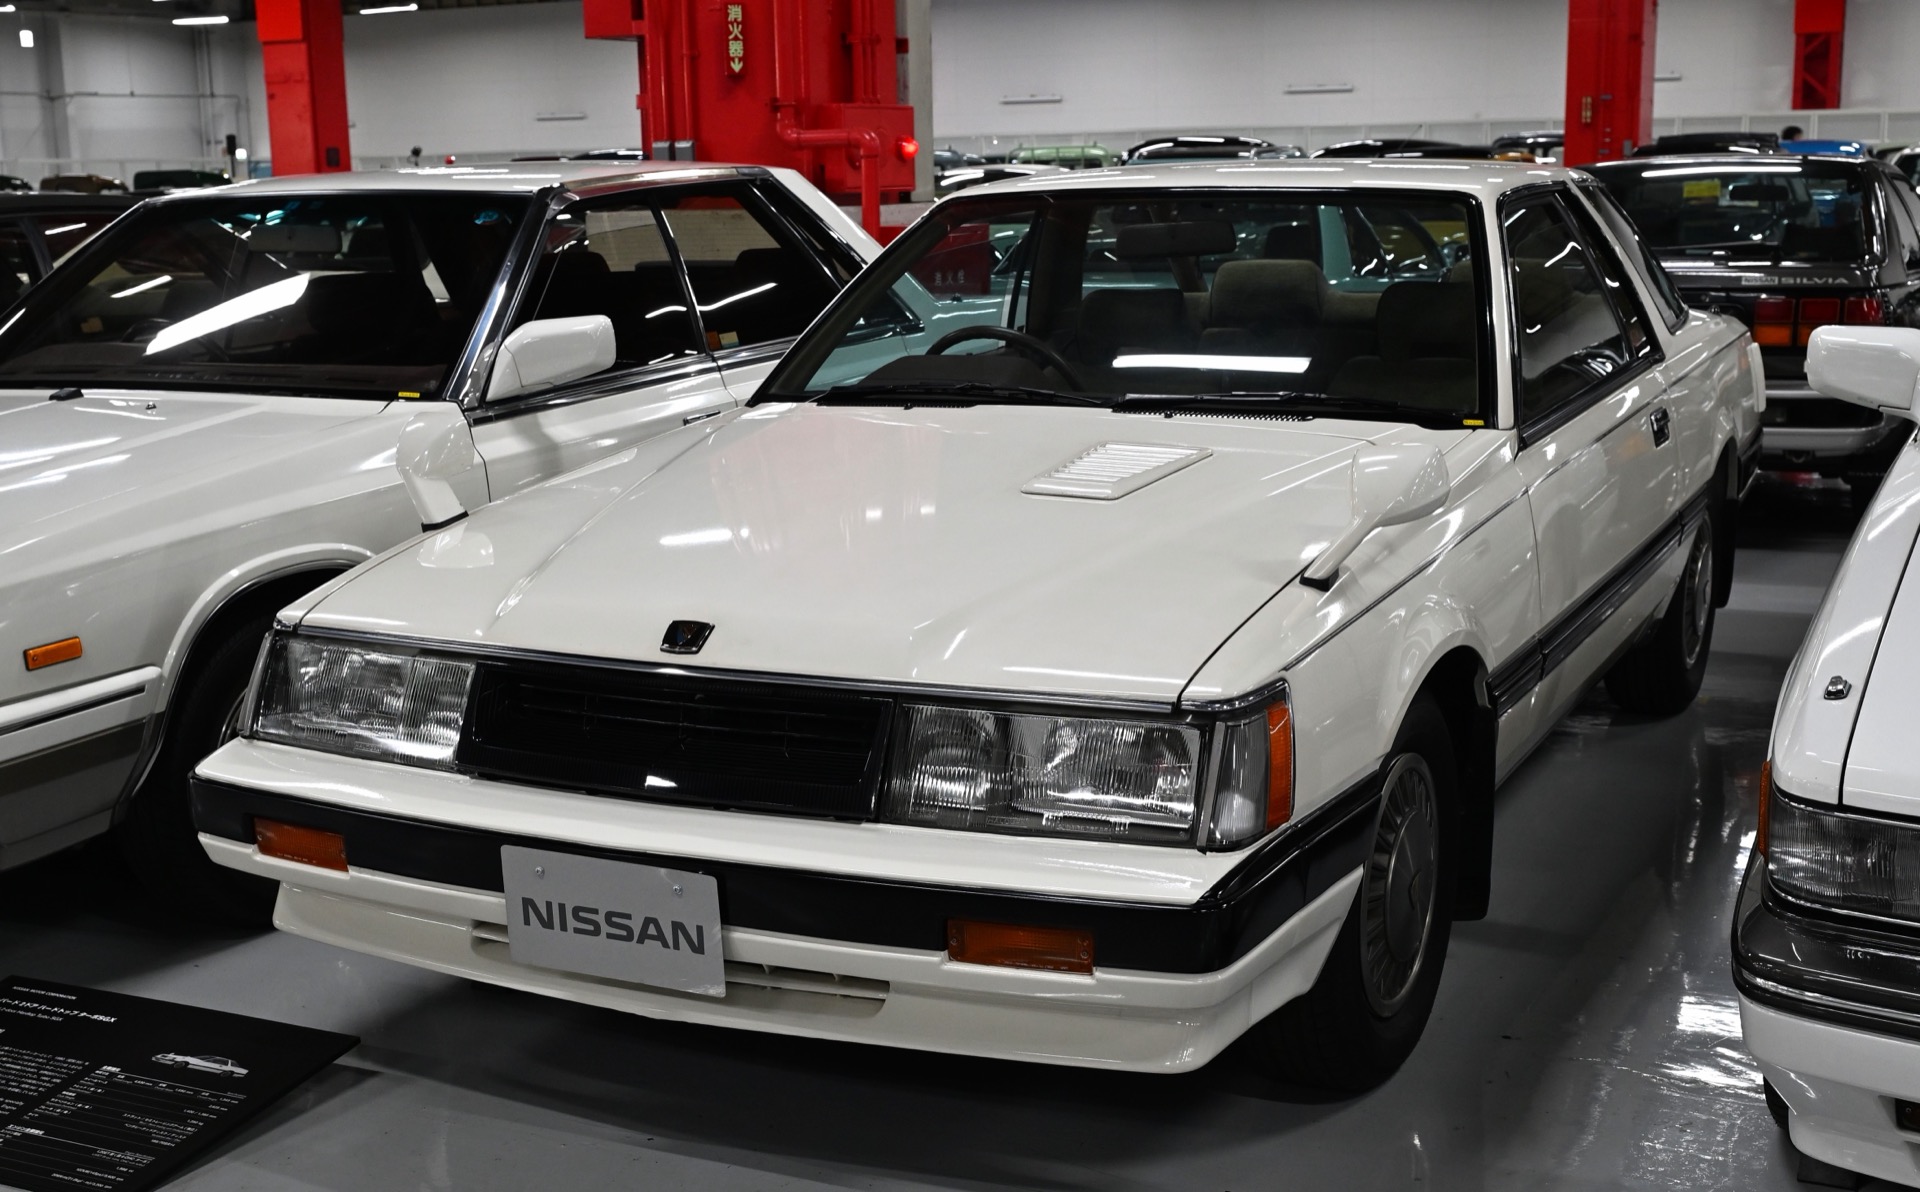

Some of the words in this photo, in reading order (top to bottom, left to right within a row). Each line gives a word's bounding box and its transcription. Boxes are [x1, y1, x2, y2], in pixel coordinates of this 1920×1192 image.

[727, 4, 744, 57] 消火器
[1743, 277, 1776, 285] NISSAN
[1781, 277, 1849, 285] SILVIA
[521, 897, 705, 955] NISSAN
